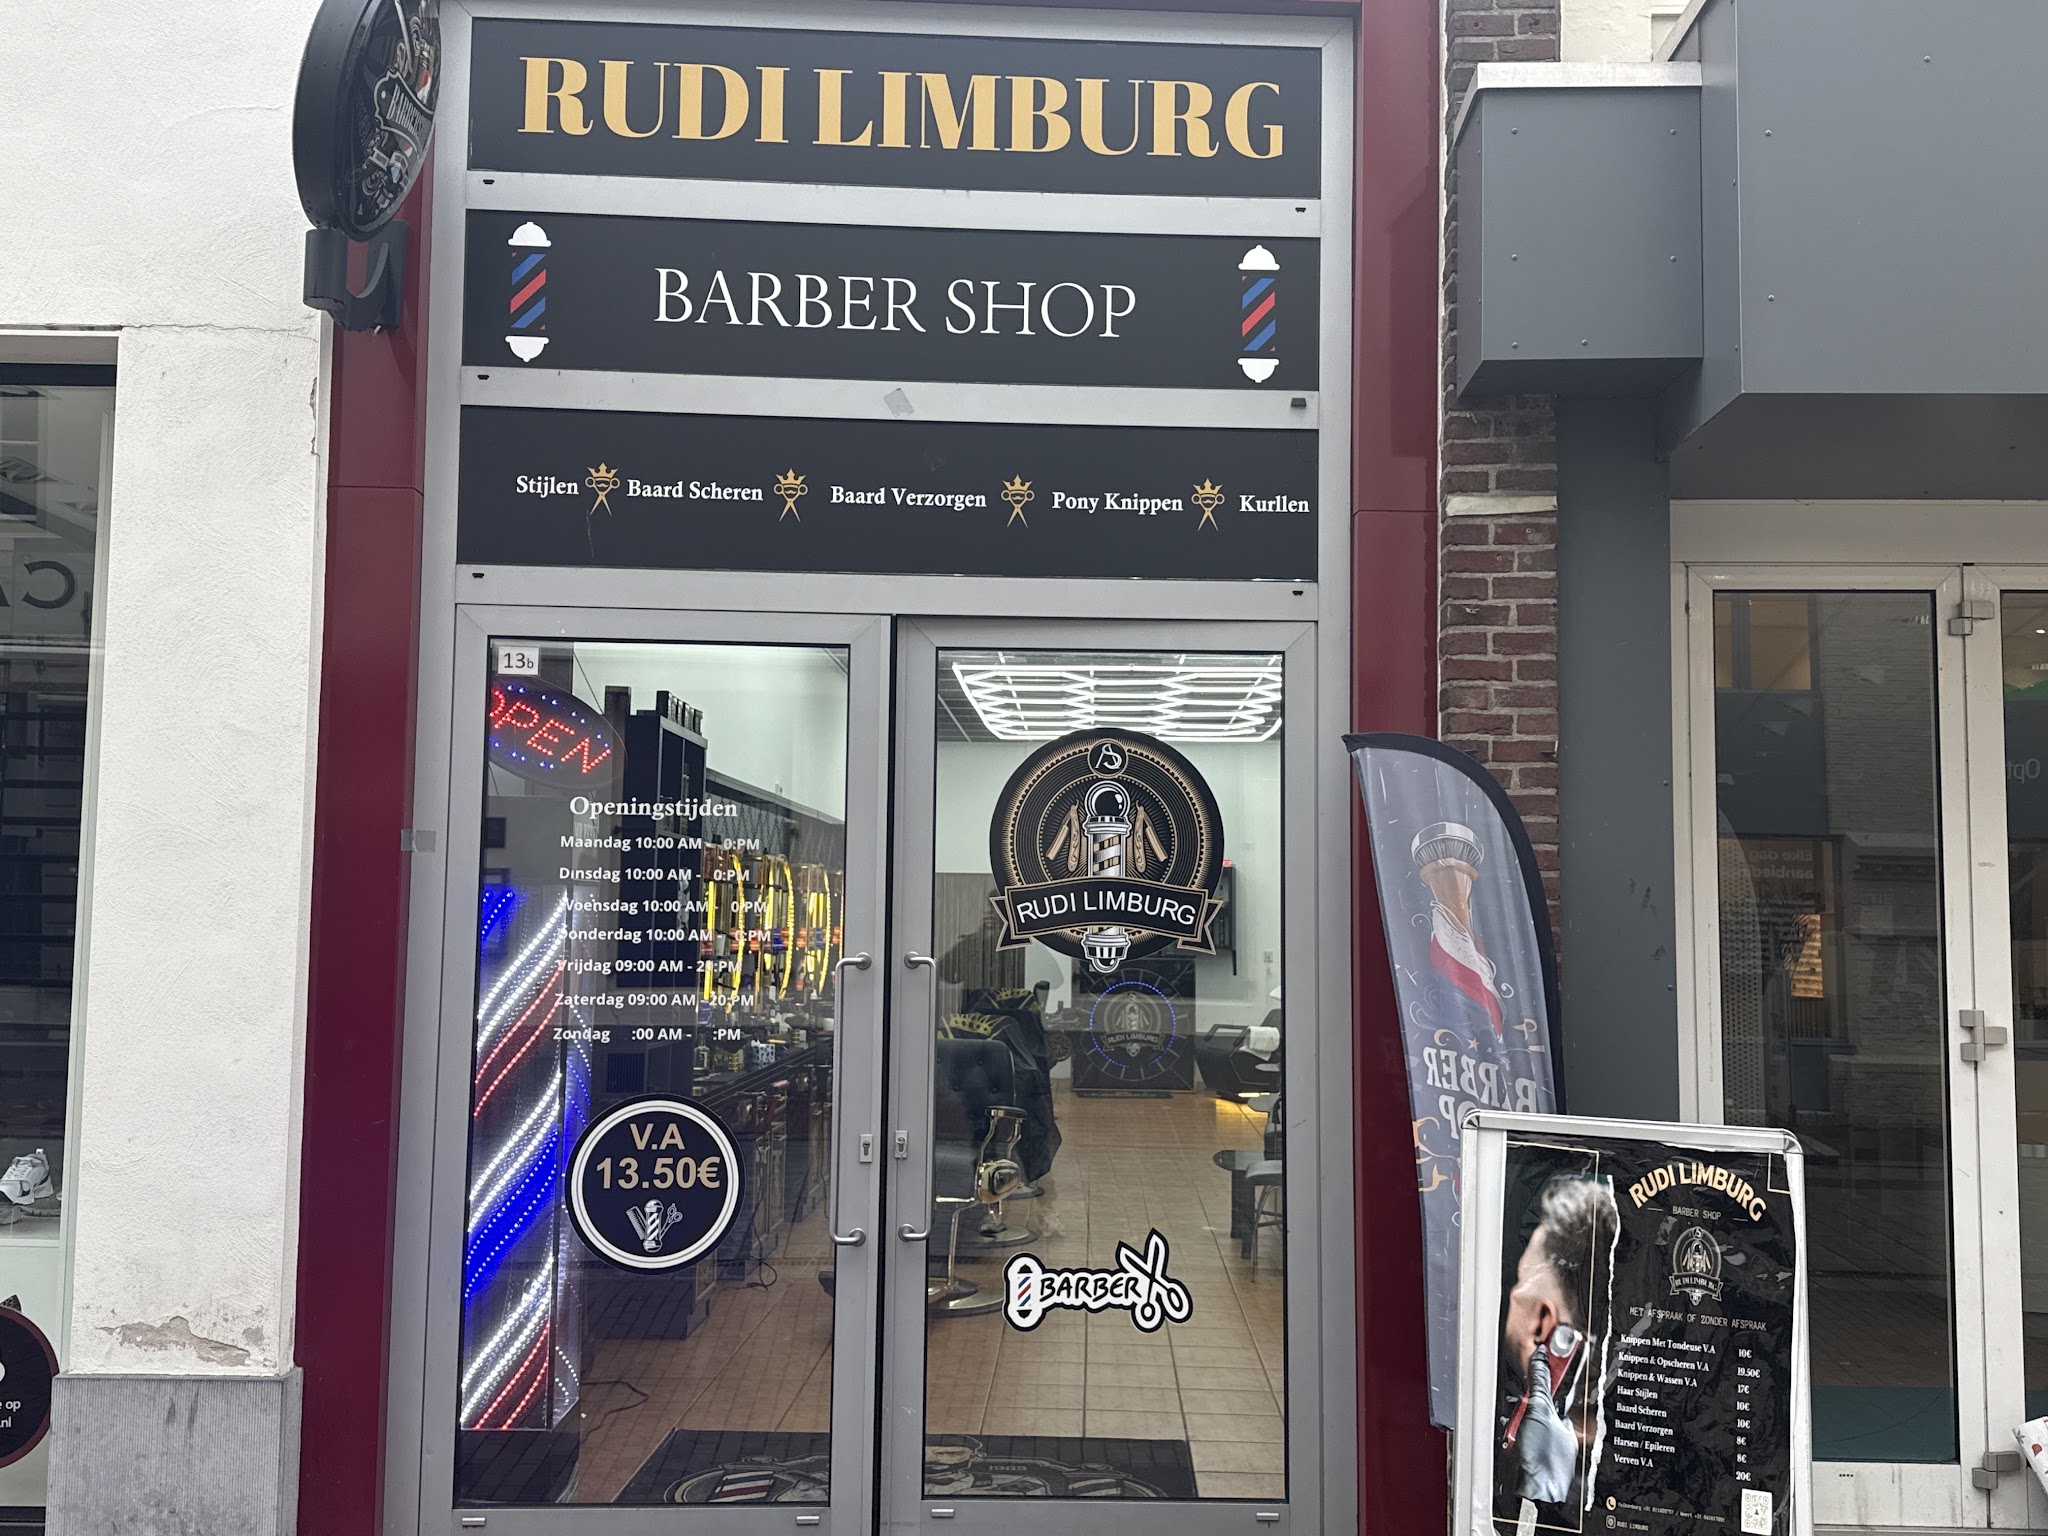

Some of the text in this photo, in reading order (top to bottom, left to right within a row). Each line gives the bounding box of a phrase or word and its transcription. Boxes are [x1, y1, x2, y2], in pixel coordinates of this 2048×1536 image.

[518, 56, 1284, 160] RUDI LIMBURG
[653, 267, 1136, 339] BARBER SHOP
[515, 475, 579, 498] Stijlen
[626, 479, 764, 503] Baard Scheren
[830, 485, 987, 509] Baard Verzorgen
[1052, 491, 1184, 515] Pony Knippen
[1239, 494, 1310, 514] Kurllen
[503, 652, 535, 670] 13b
[569, 796, 738, 821] Openingstijden
[560, 836, 632, 851] Maandag
[635, 837, 674, 849] 10:00
[677, 838, 702, 849] AM
[625, 868, 664, 880] 10:00
[667, 869, 692, 880] AM
[642, 900, 682, 912] 10:00
[684, 901, 709, 912] AM
[1016, 890, 1196, 925] RUDI LIMBURG
[646, 929, 685, 941] 10:00
[688, 930, 713, 941] AM
[557, 958, 612, 975] Vrijdag
[615, 960, 655, 972] 09:00
[658, 960, 683, 972] AM
[555, 993, 625, 1009] Zaterdag
[628, 994, 668, 1006] 09:00
[671, 994, 696, 1006] AM
[553, 1027, 611, 1043] Zondag
[631, 1028, 654, 1040] :00
[657, 1028, 683, 1040] AM
[629, 1123, 686, 1150] V.A
[596, 1156, 721, 1189] 13.50€
[1628, 1162, 1767, 1222] RUDI LIMBURG
[1672, 1205, 1721, 1220] BARBER SHOP
[1039, 1276, 1142, 1303] BARBER
[1629, 1306, 1767, 1331] MET AFSPRAAK OF ZONDER AFSPRAAK
[1620, 1334, 1752, 1359] Knippen Met Tondeuse V.A 10€
[1618, 1352, 1761, 1378] Knippen & Opscheren V.A 19.50€
[1617, 1369, 1749, 1394] Knippen & Wassen V.A 17€
[5, 1400, 21, 1412] op
[1617, 1385, 1750, 1411] Haar Stijlen 10€
[1616, 1402, 1750, 1429] Baard Scheren 10€
[1615, 1419, 1747, 1446] Baard Verzorgen 8€
[1613, 1436, 1639, 1448] Harsen
[1644, 1441, 1675, 1453] Epileren
[1736, 1454, 1747, 1463] 8€
[1613, 1453, 1751, 1481] Verven V.A 20€
